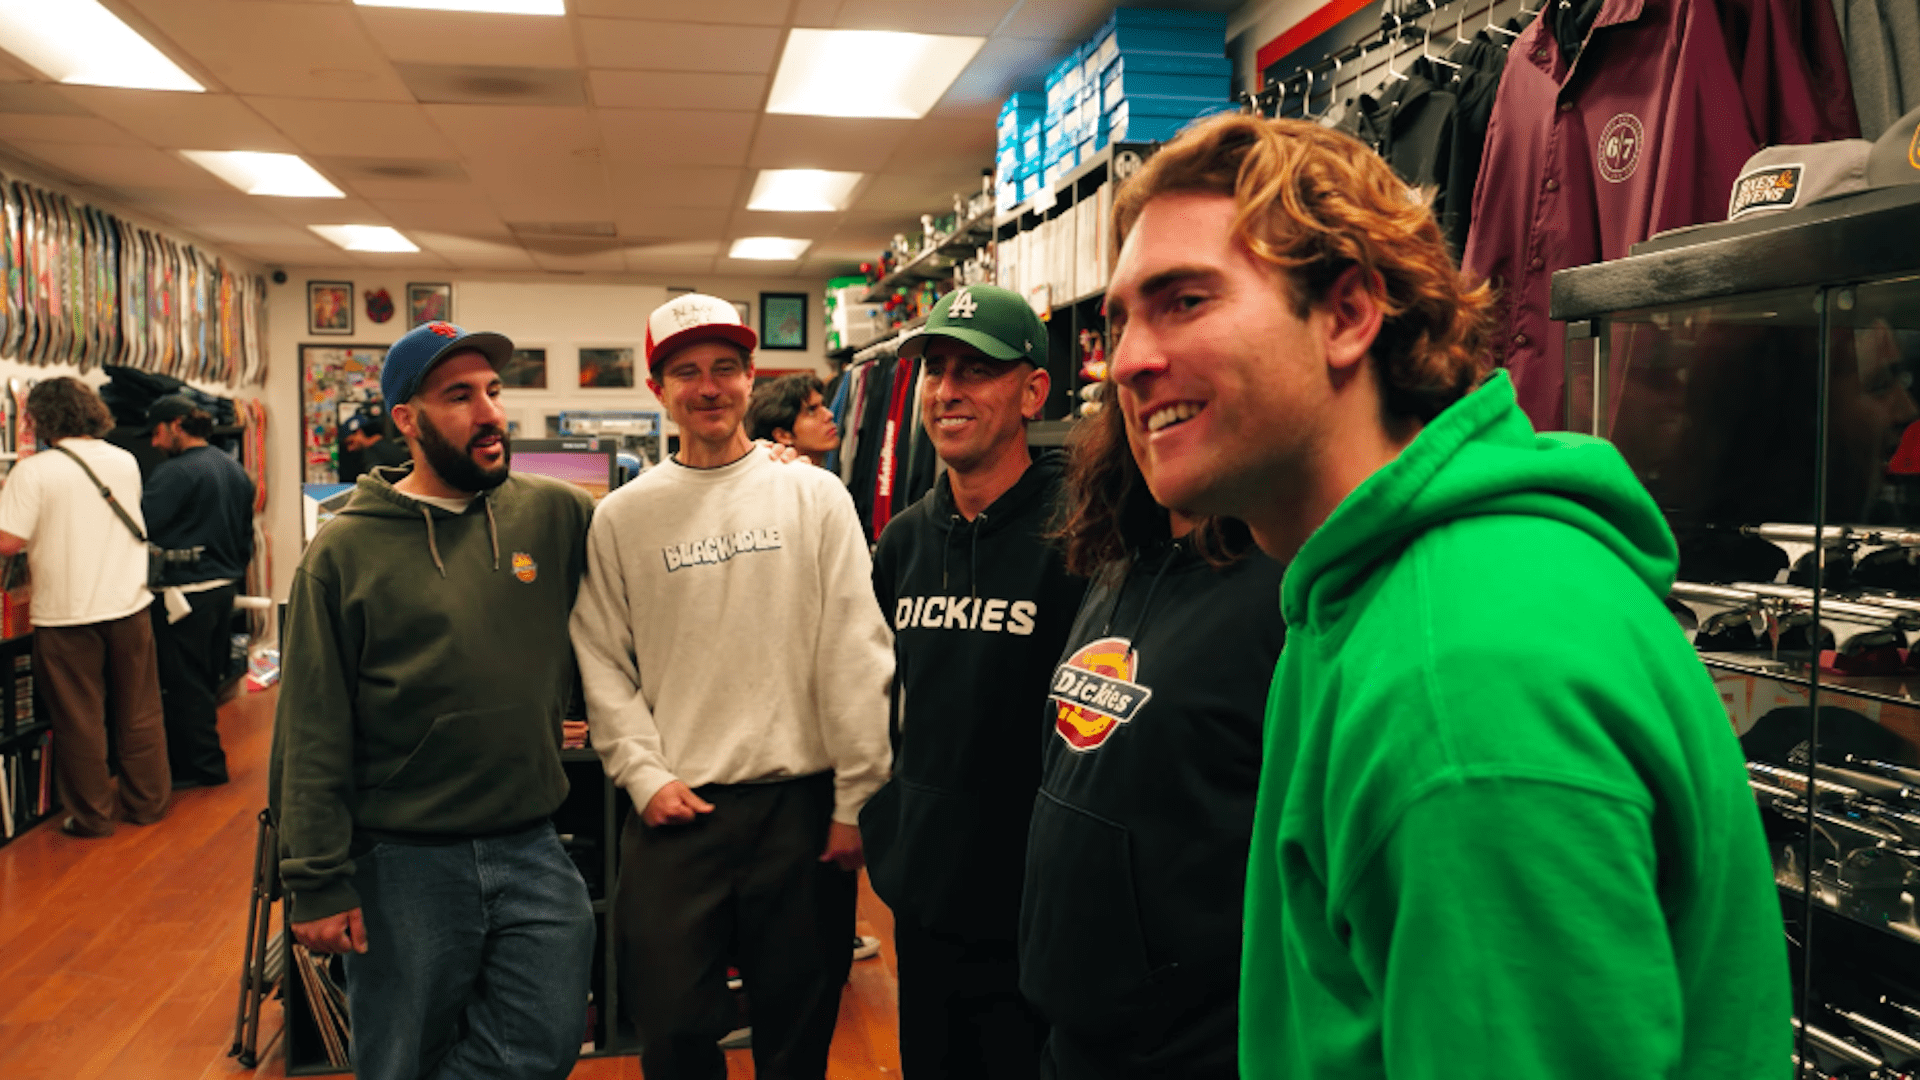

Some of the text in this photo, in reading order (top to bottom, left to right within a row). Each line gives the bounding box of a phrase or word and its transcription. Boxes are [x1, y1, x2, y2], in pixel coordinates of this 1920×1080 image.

[948, 287, 978, 318] LA
[896, 596, 1038, 636] DICKIES
[1053, 670, 1134, 713] Dickies
